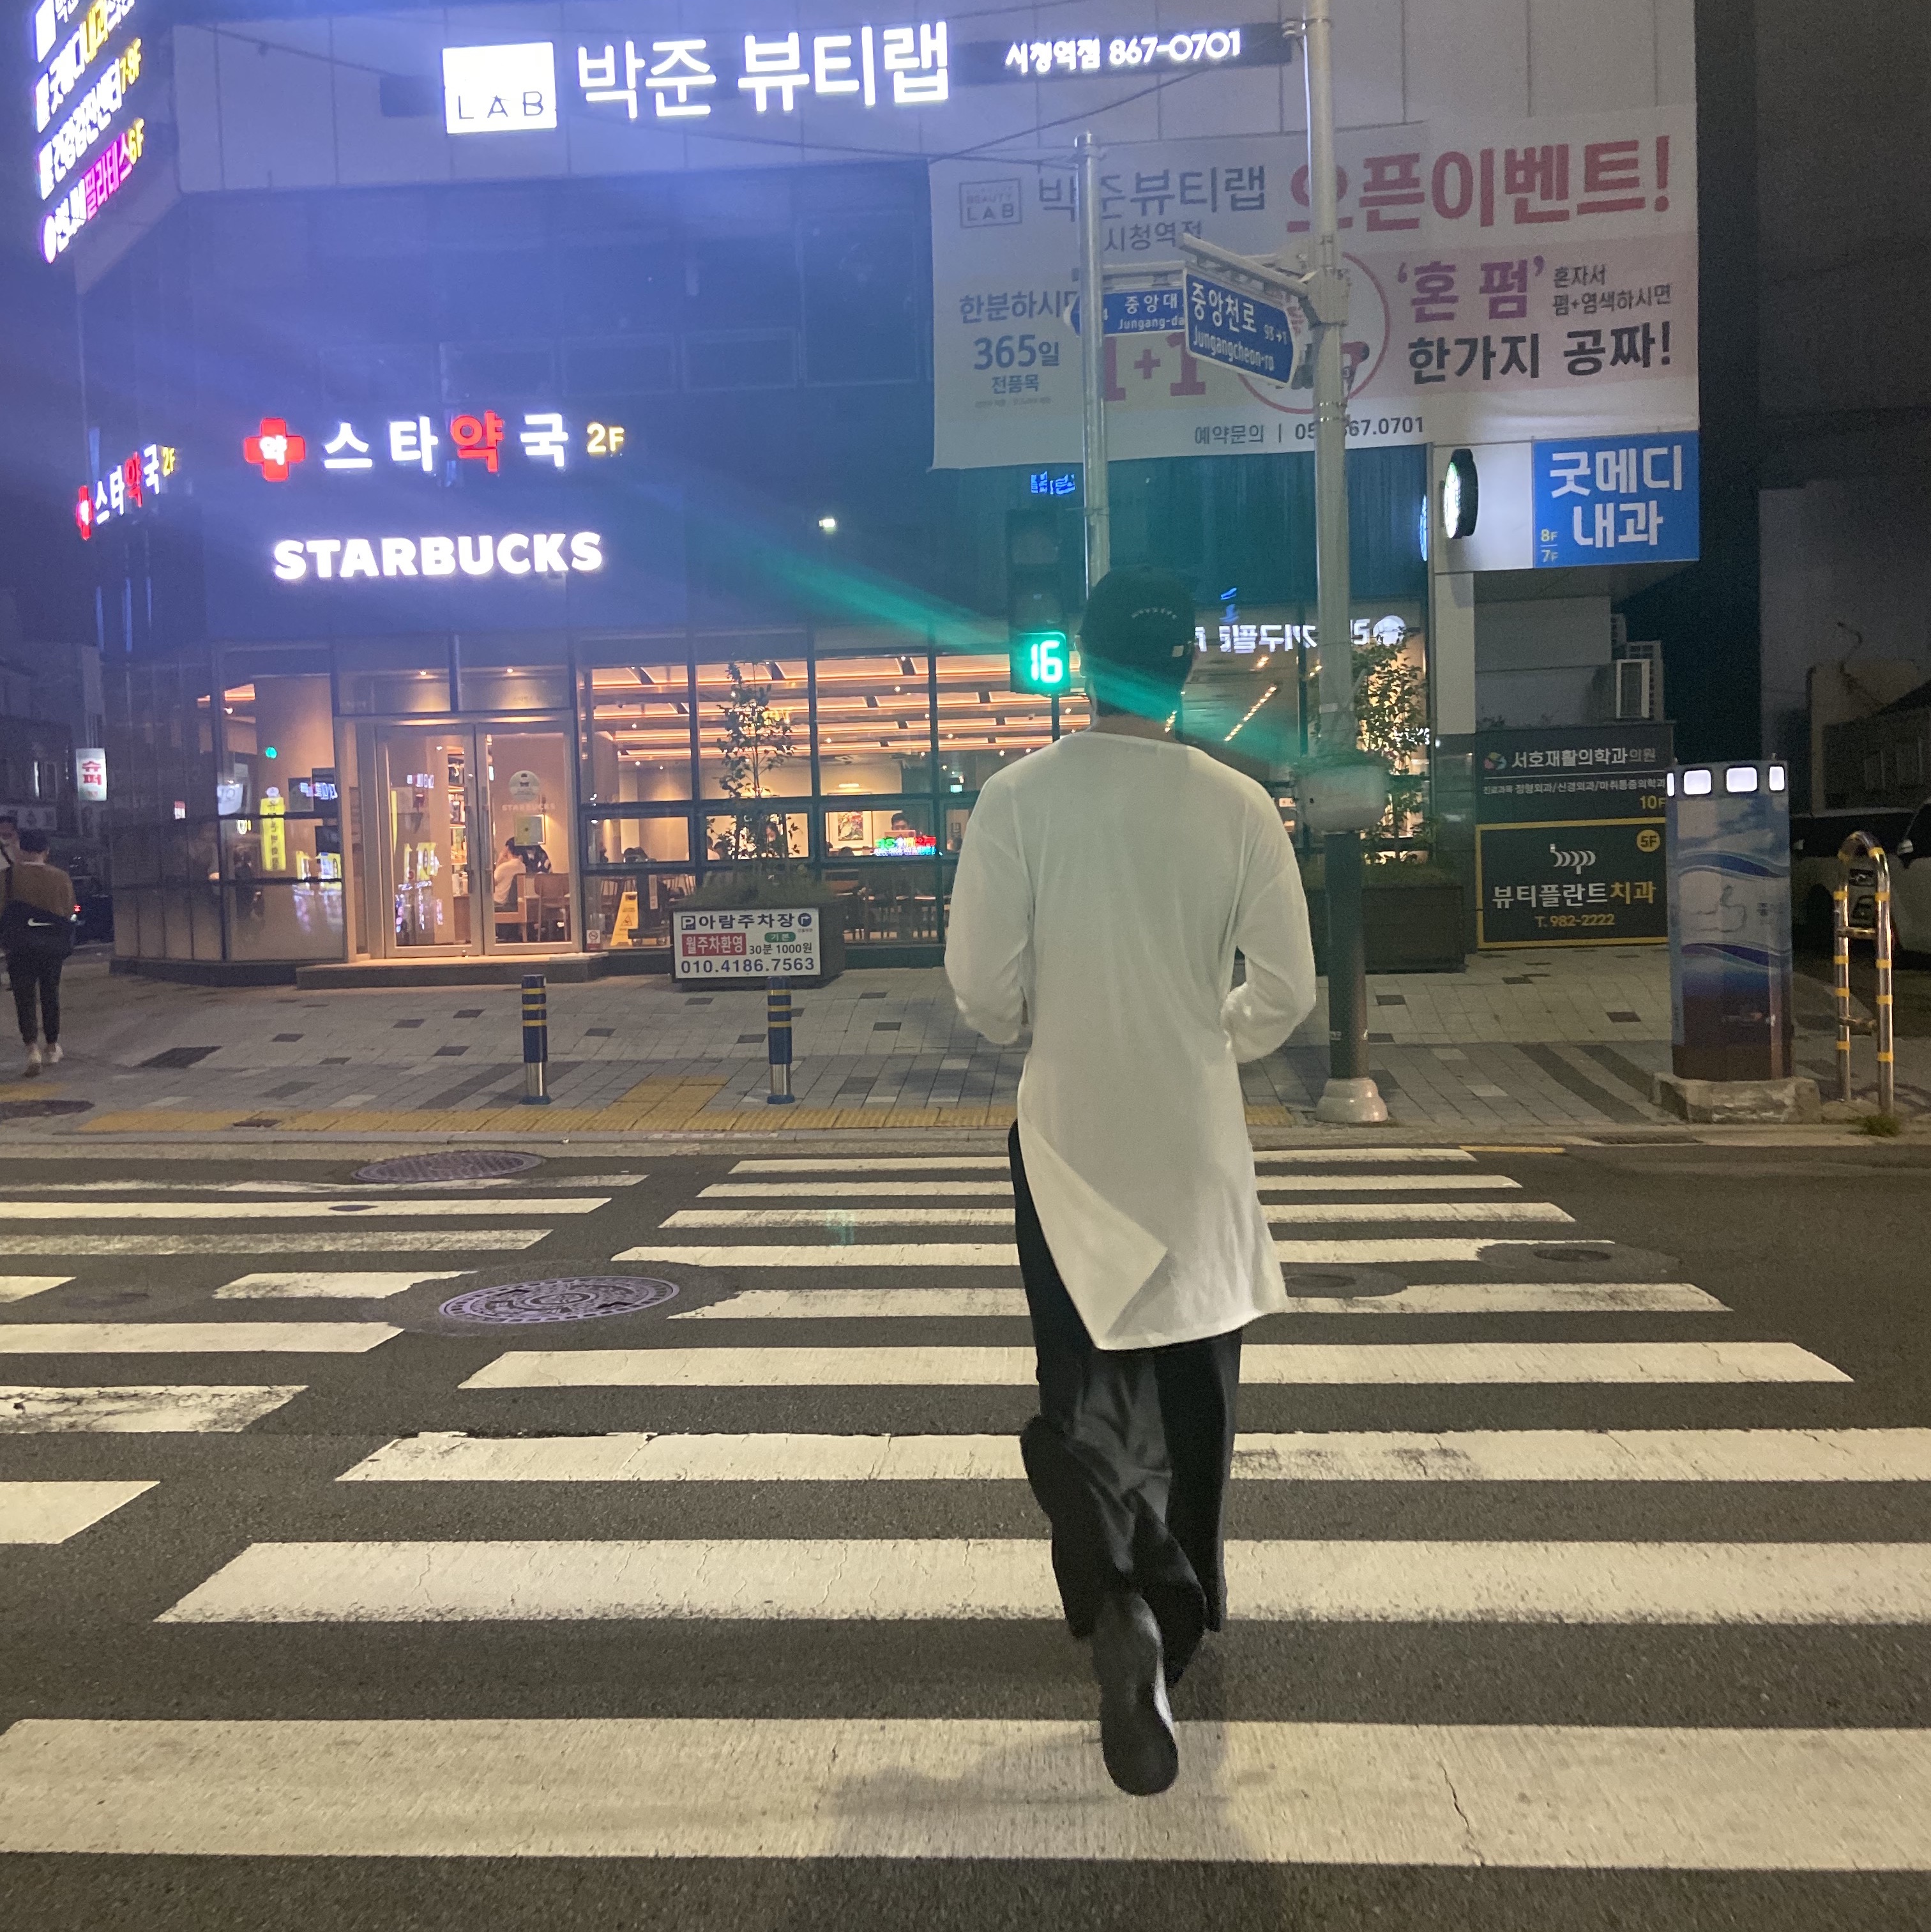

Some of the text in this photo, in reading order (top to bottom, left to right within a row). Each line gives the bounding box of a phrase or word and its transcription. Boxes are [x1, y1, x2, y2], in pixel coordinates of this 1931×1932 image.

[1004, 29, 1241, 73] 시청역점 867-0701
[577, 21, 949, 119] 박준 뷰티랩
[457, 91, 545, 120] LAB
[128, 118, 144, 165] 6F
[967, 203, 1014, 221] LAB
[1554, 264, 1606, 288] 혼자서
[1125, 293, 1184, 314] 중앙대
[1192, 282, 1257, 333] 중앙천로
[1118, 314, 1185, 330] Jungang-da
[974, 334, 1059, 370] 365일
[1193, 324, 1275, 371] Jungangcheon-ro
[1408, 321, 1670, 384] 한가지 공짜!
[992, 374, 1040, 394] 전품목
[324, 410, 570, 471] 스타약국
[586, 422, 625, 453] 2F
[1195, 416, 1423, 445] 예약문의 0567.0701
[96, 444, 160, 525] 스타약국
[162, 446, 175, 477] 2F
[1549, 445, 1683, 499] 굿메디
[1541, 529, 1558, 542] 8F
[1573, 500, 1664, 548] 내과
[273, 531, 604, 581] STARBUCKS
[1541, 549, 1558, 562] 7F
[1030, 639, 1063, 683] 16
[1511, 747, 1656, 768] 서호재활의학과의원
[82, 761, 102, 786] 슈퍼
[1640, 795, 1666, 810] 10F
[1640, 835, 1657, 848] 5F
[1492, 881, 1657, 909] 뷰티플란트치과
[699, 913, 795, 929] 아람주차장
[1550, 914, 1616, 927] 982-2222
[685, 936, 743, 955] 월주차환영
[749, 942, 813, 955] 30분 1000원
[770, 933, 791, 941] 기본
[681, 957, 815, 973] 010.4186.7563
